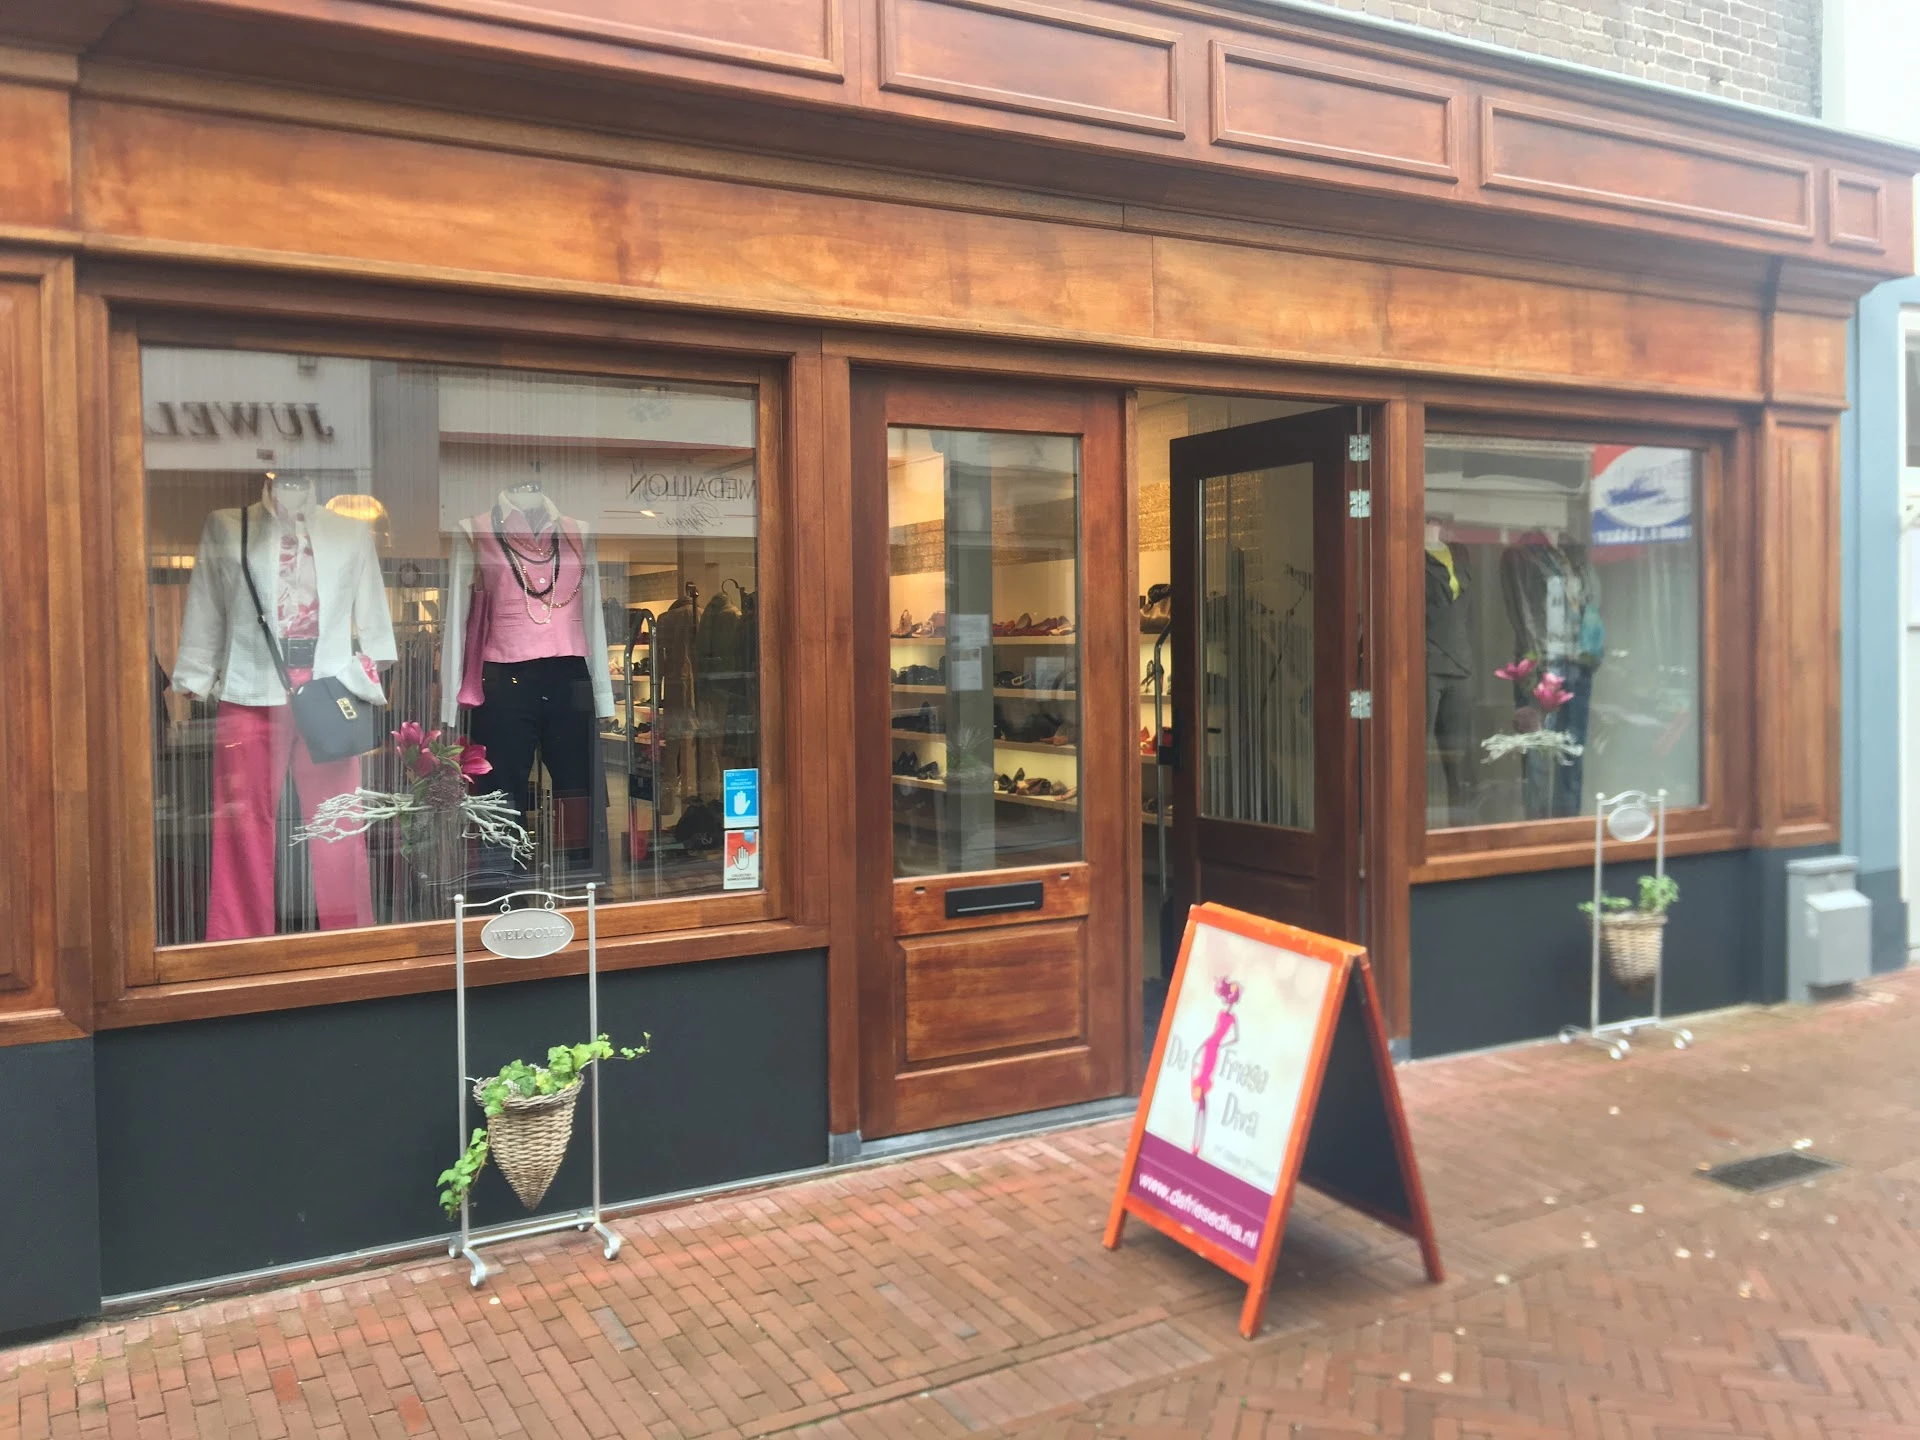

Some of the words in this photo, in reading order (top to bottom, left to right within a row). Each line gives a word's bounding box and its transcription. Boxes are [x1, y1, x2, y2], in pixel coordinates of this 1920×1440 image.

[490, 925, 566, 942] WELCOME
[1167, 1034, 1189, 1072] De
[1221, 1091, 1259, 1139] Diva
[1139, 1173, 1259, 1249] www.defriesediva.nl
